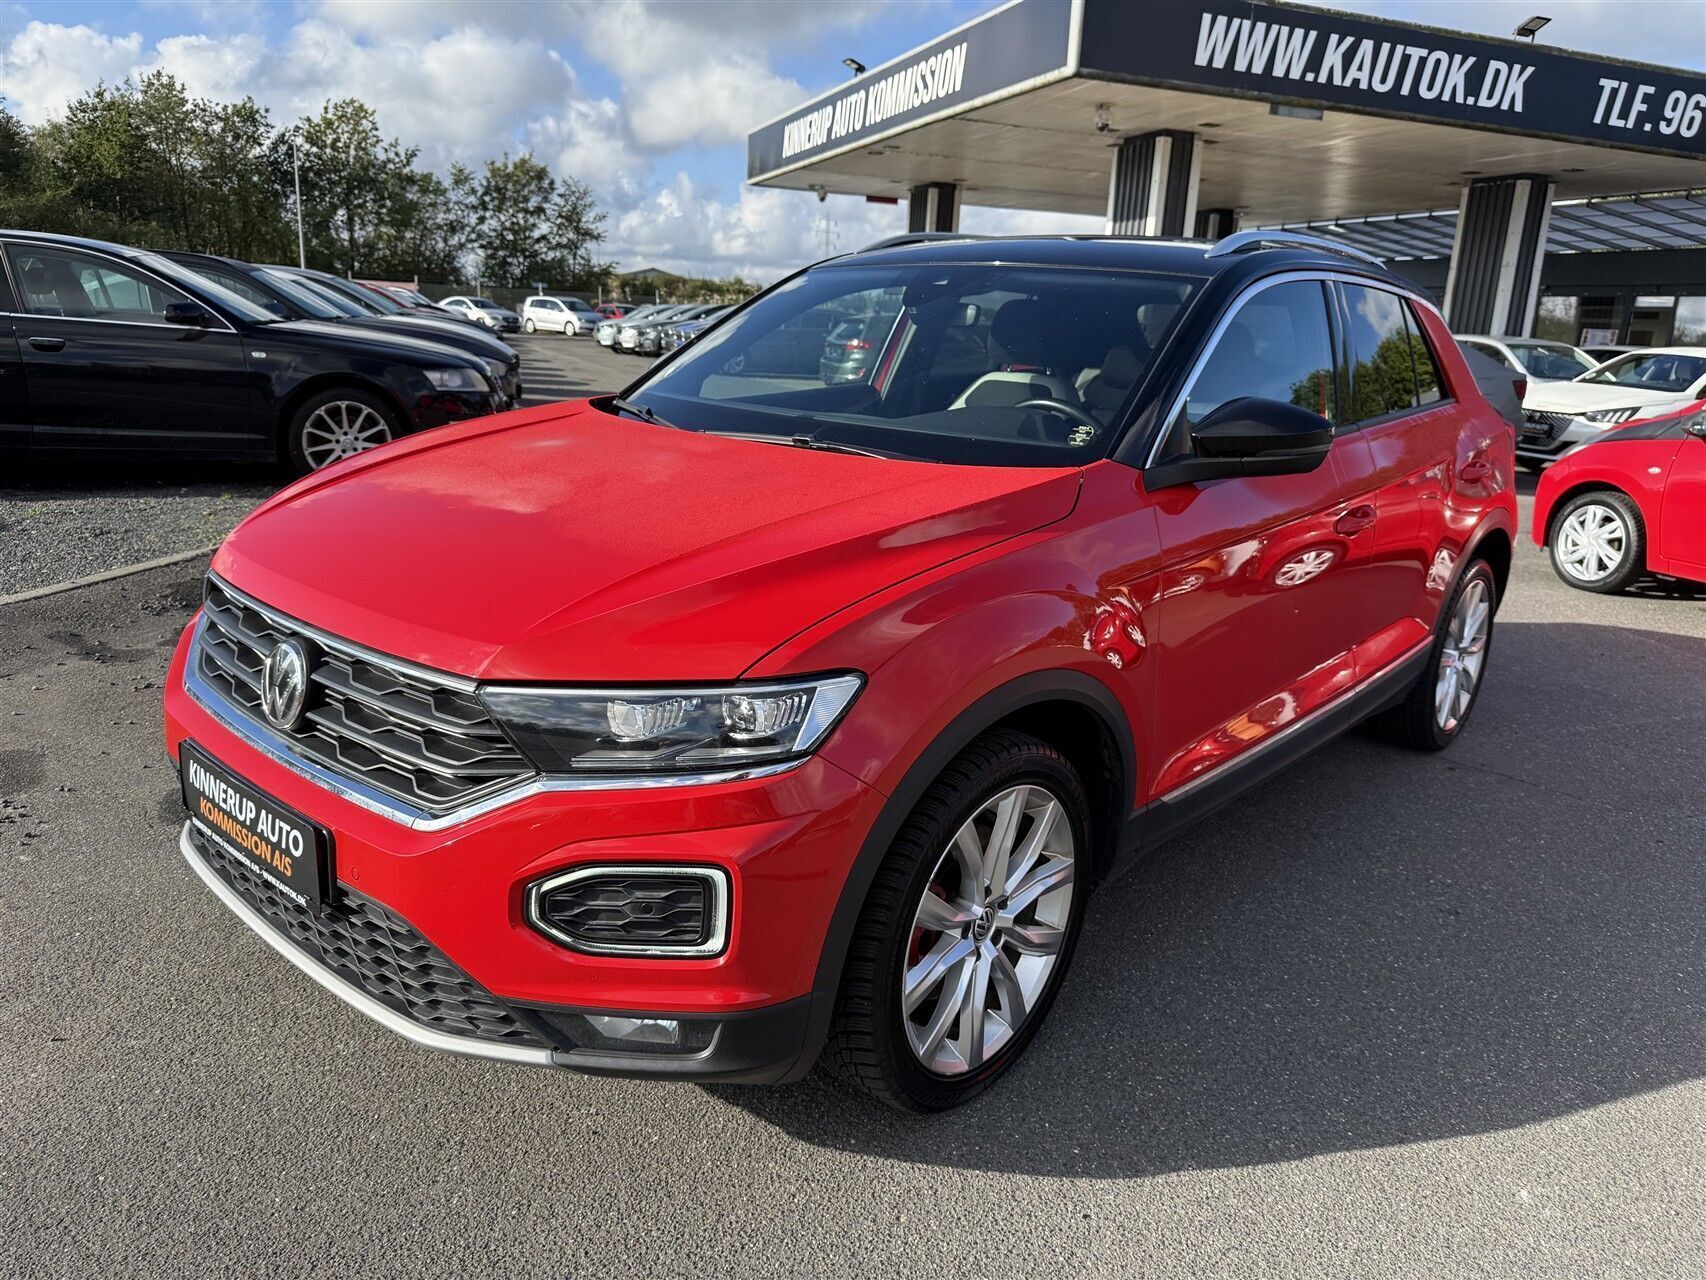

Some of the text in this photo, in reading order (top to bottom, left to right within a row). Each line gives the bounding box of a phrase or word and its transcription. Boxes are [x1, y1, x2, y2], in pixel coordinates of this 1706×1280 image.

[782, 42, 968, 159] KINNERUP AUTO KOMMISSION
[1194, 12, 1536, 113] WWW.KAUTOK.DK
[189, 759, 304, 858] KINNERUP AUTO
[199, 796, 272, 864] KOMMISSION
